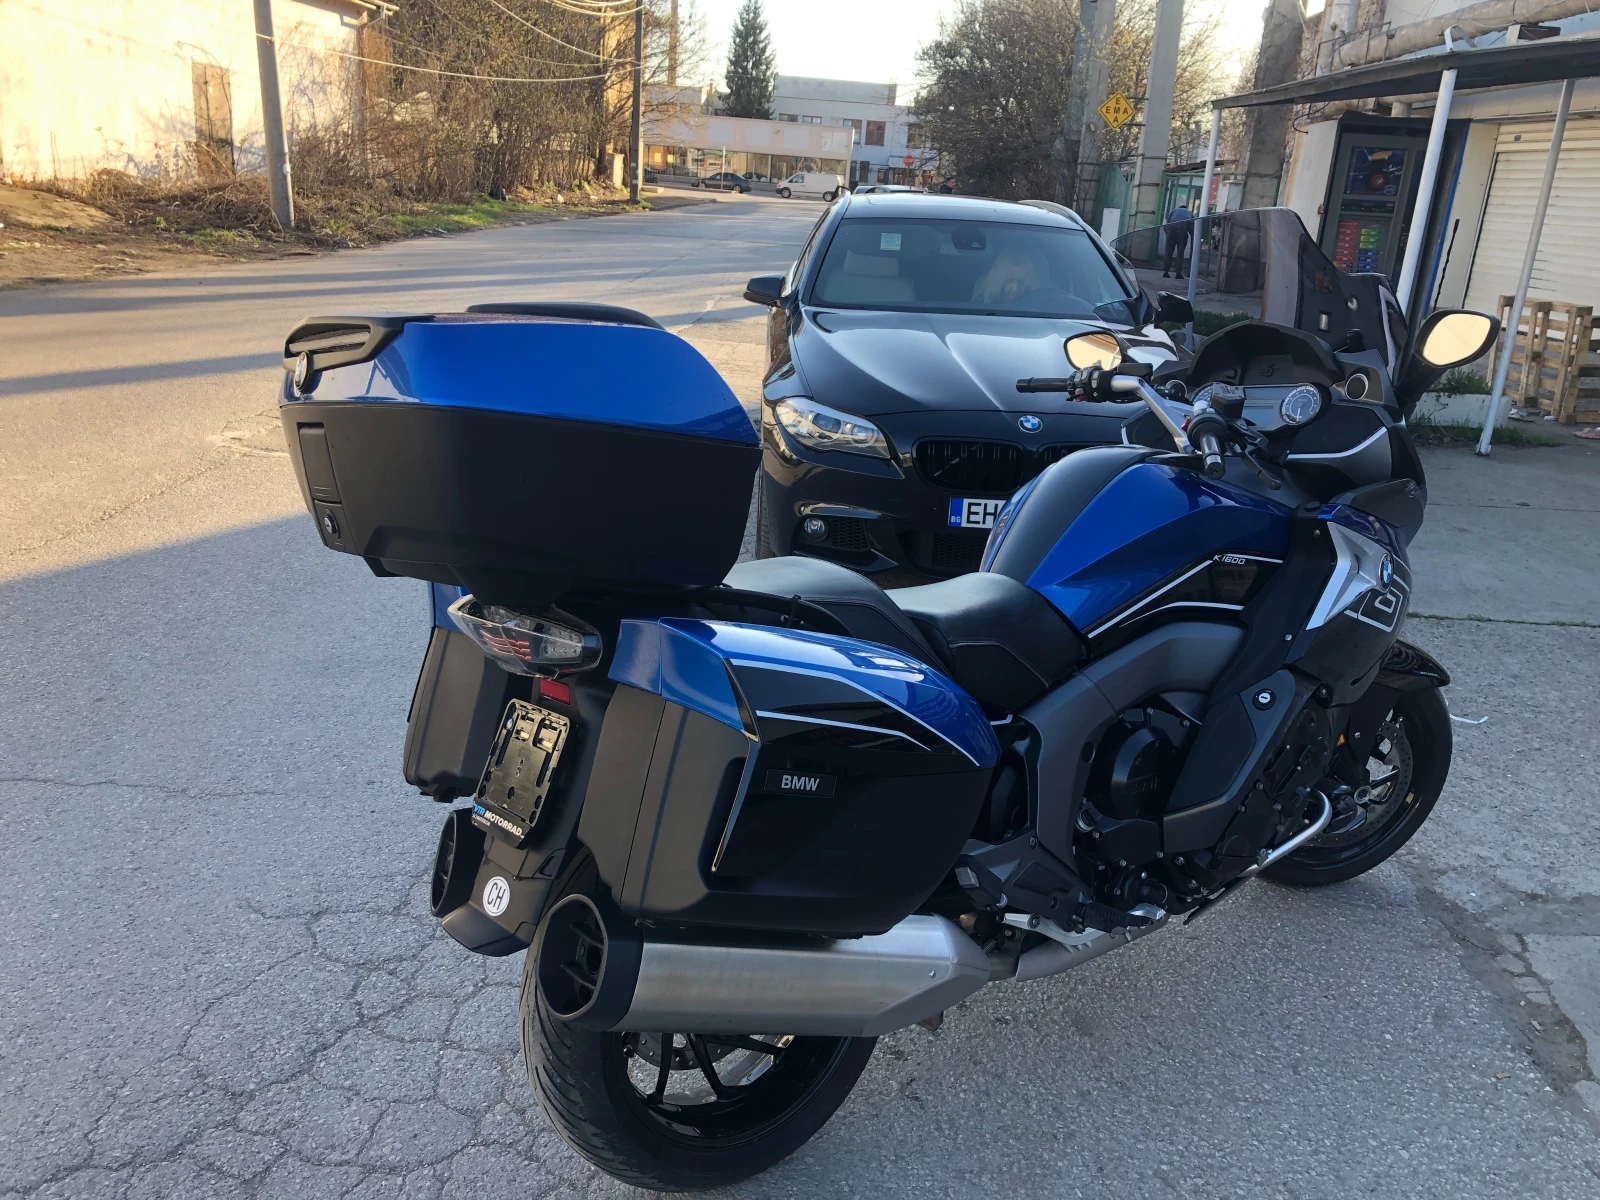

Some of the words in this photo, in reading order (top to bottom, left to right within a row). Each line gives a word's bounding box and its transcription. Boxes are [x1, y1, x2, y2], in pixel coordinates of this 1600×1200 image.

[950, 515, 961, 523] BG
[966, 502, 999, 525] EH
[781, 774, 820, 792] BMW
[483, 809, 523, 837] MOTORRAD
[487, 882, 506, 911] CH
